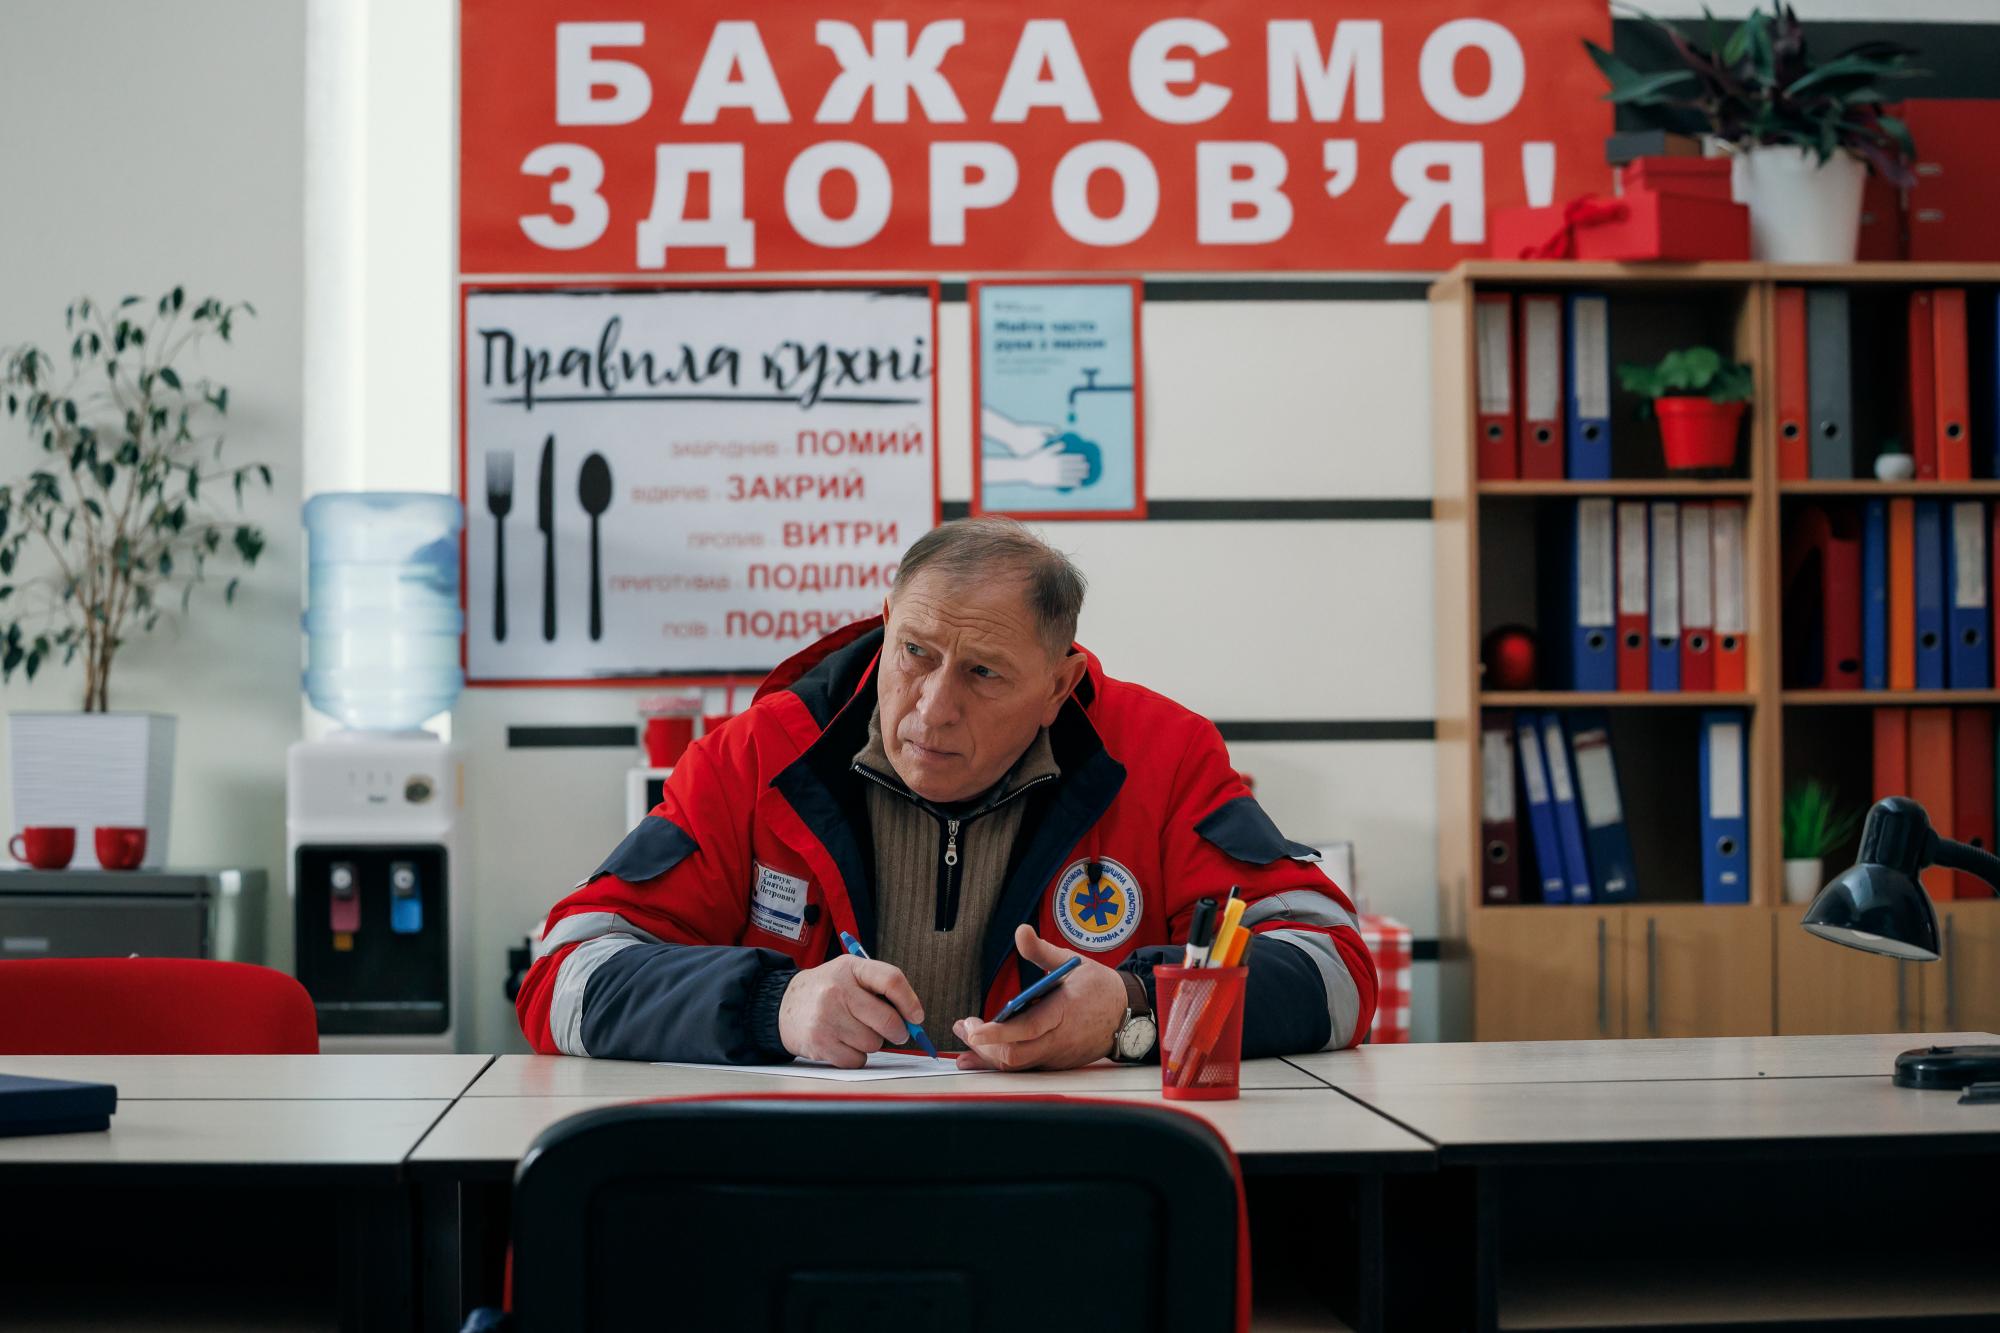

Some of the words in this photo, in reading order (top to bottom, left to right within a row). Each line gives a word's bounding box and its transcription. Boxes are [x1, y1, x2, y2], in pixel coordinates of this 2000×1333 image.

[556, 18, 1526, 126] БАЖАЄМО
[477, 315, 741, 411] Правила
[762, 338, 934, 410] кухні
[796, 423, 924, 456] ПОМИЙ
[727, 467, 865, 501] ЗАКРИЙ
[782, 521, 898, 548] ВИТРИ
[747, 563, 899, 593] ПОДІЛИС
[725, 607, 882, 640] ПОДЯК
[761, 878, 796, 895] Анатолій
[763, 870, 791, 885] Савчук
[760, 885, 796, 903] Петрович
[1101, 864, 1127, 885] ЕДИЦИНА
[1125, 887, 1136, 925] КАТАСТРОФ
[1092, 931, 1120, 943] УКРАЇНА
